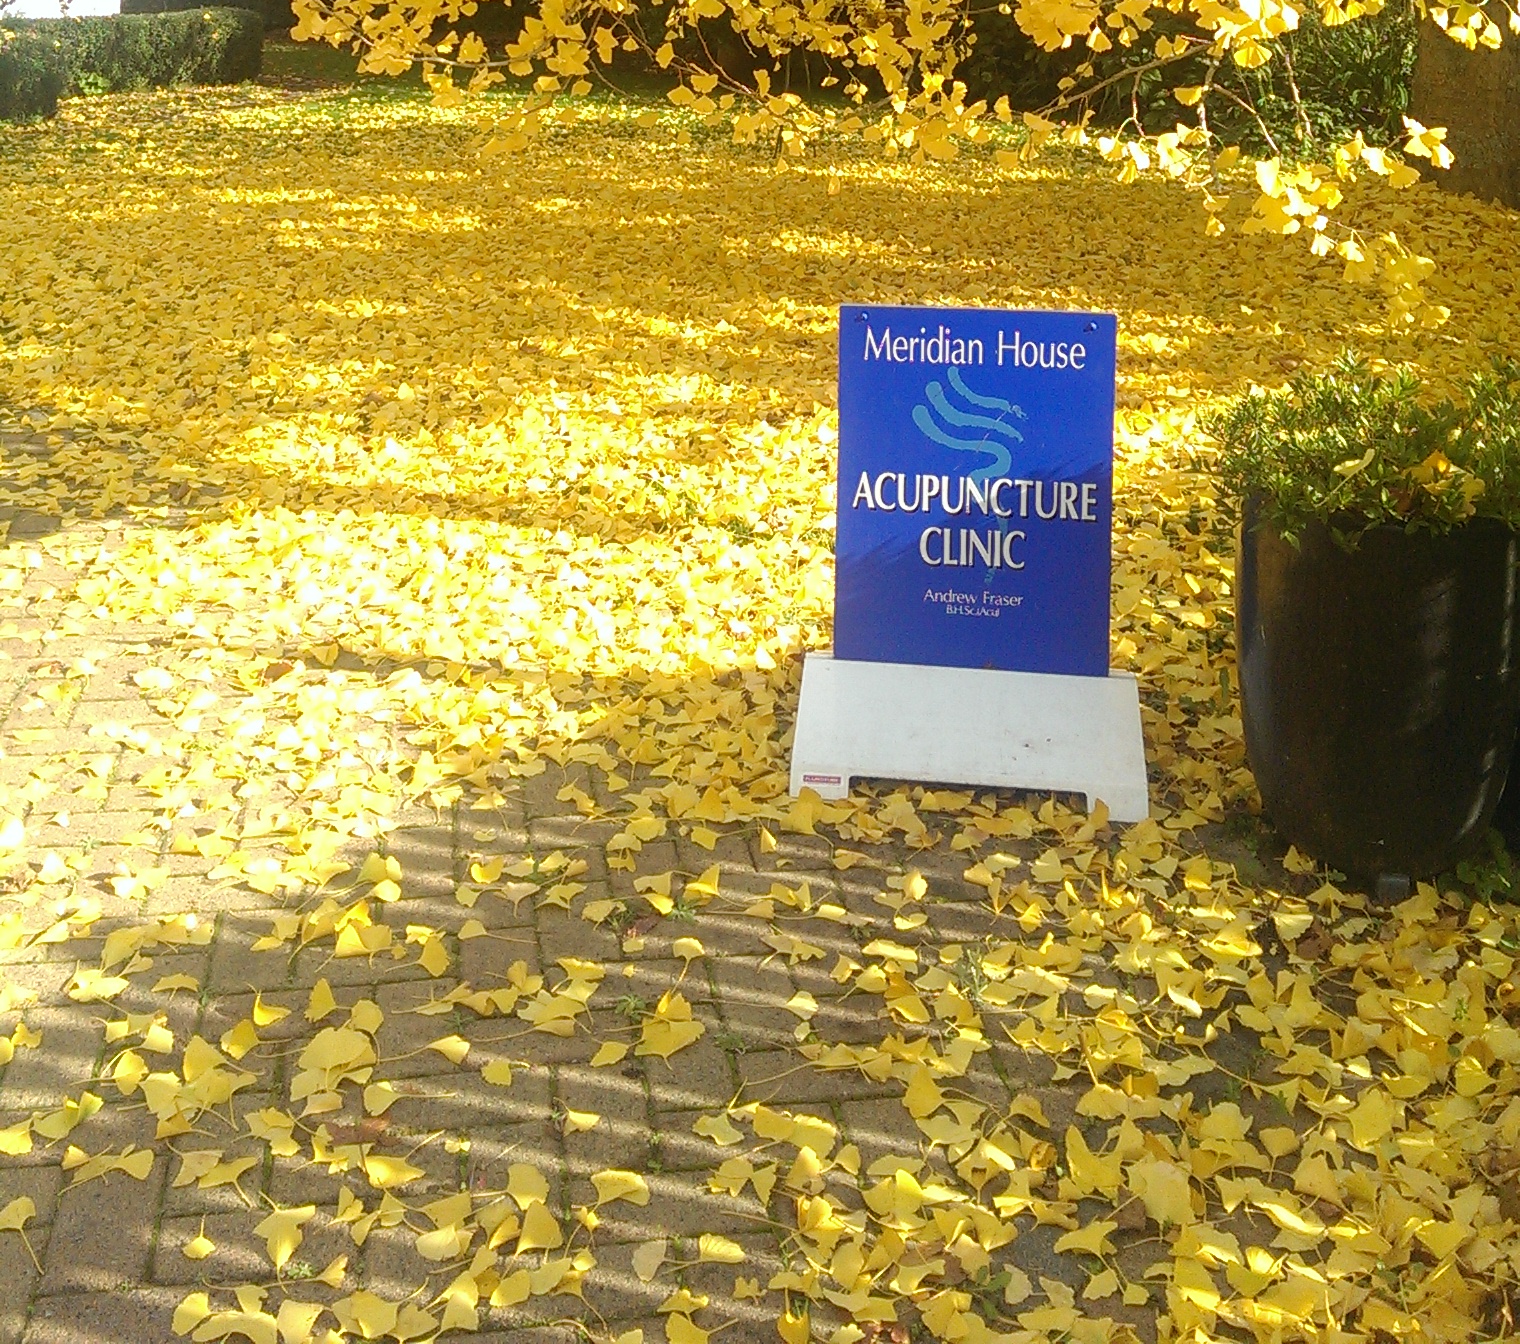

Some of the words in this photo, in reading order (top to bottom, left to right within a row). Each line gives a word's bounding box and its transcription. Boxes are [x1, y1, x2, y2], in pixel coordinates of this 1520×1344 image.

[864, 325, 983, 365] Meridian
[997, 330, 1087, 369] House
[852, 470, 1098, 522] ACUPUNCTURE
[919, 526, 1028, 569] CLINIC
[923, 588, 977, 604] Andrew
[983, 591, 1024, 607] Fraser
